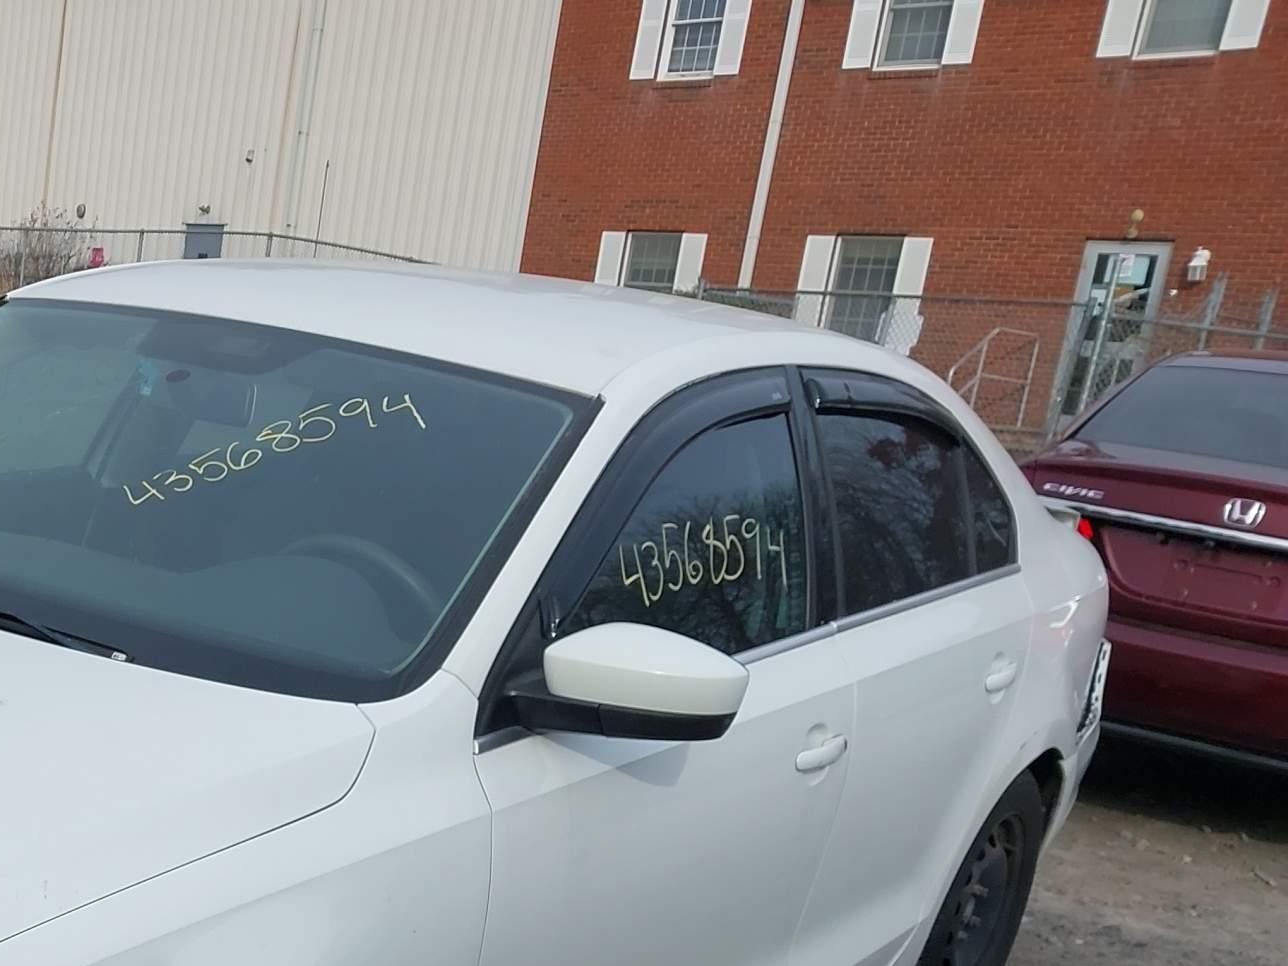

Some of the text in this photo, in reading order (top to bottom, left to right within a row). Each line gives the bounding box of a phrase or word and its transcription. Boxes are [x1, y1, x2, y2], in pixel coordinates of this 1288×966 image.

[123, 393, 427, 505] 43568594
[1043, 482, 1105, 500] CIVIC
[619, 514, 789, 608] 43568594
